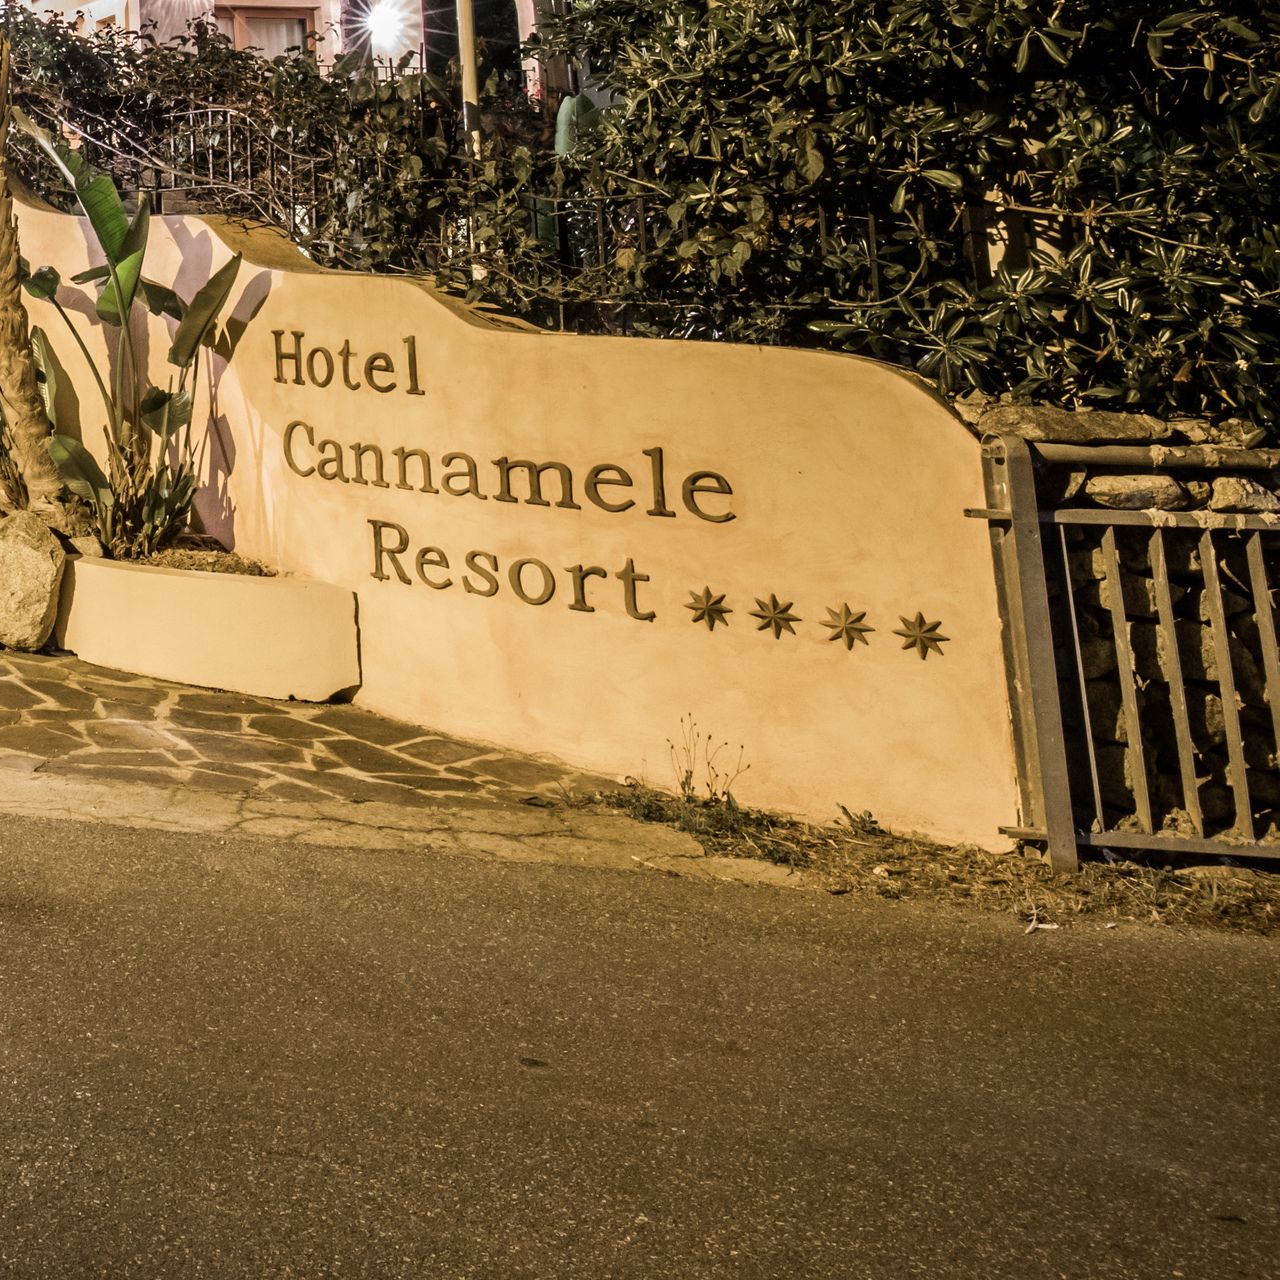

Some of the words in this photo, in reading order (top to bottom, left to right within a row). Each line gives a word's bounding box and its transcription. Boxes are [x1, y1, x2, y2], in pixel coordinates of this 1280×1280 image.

[270, 328, 426, 397] Hotel
[282, 419, 738, 524] Cannamele
[366, 518, 657, 623] Resort
